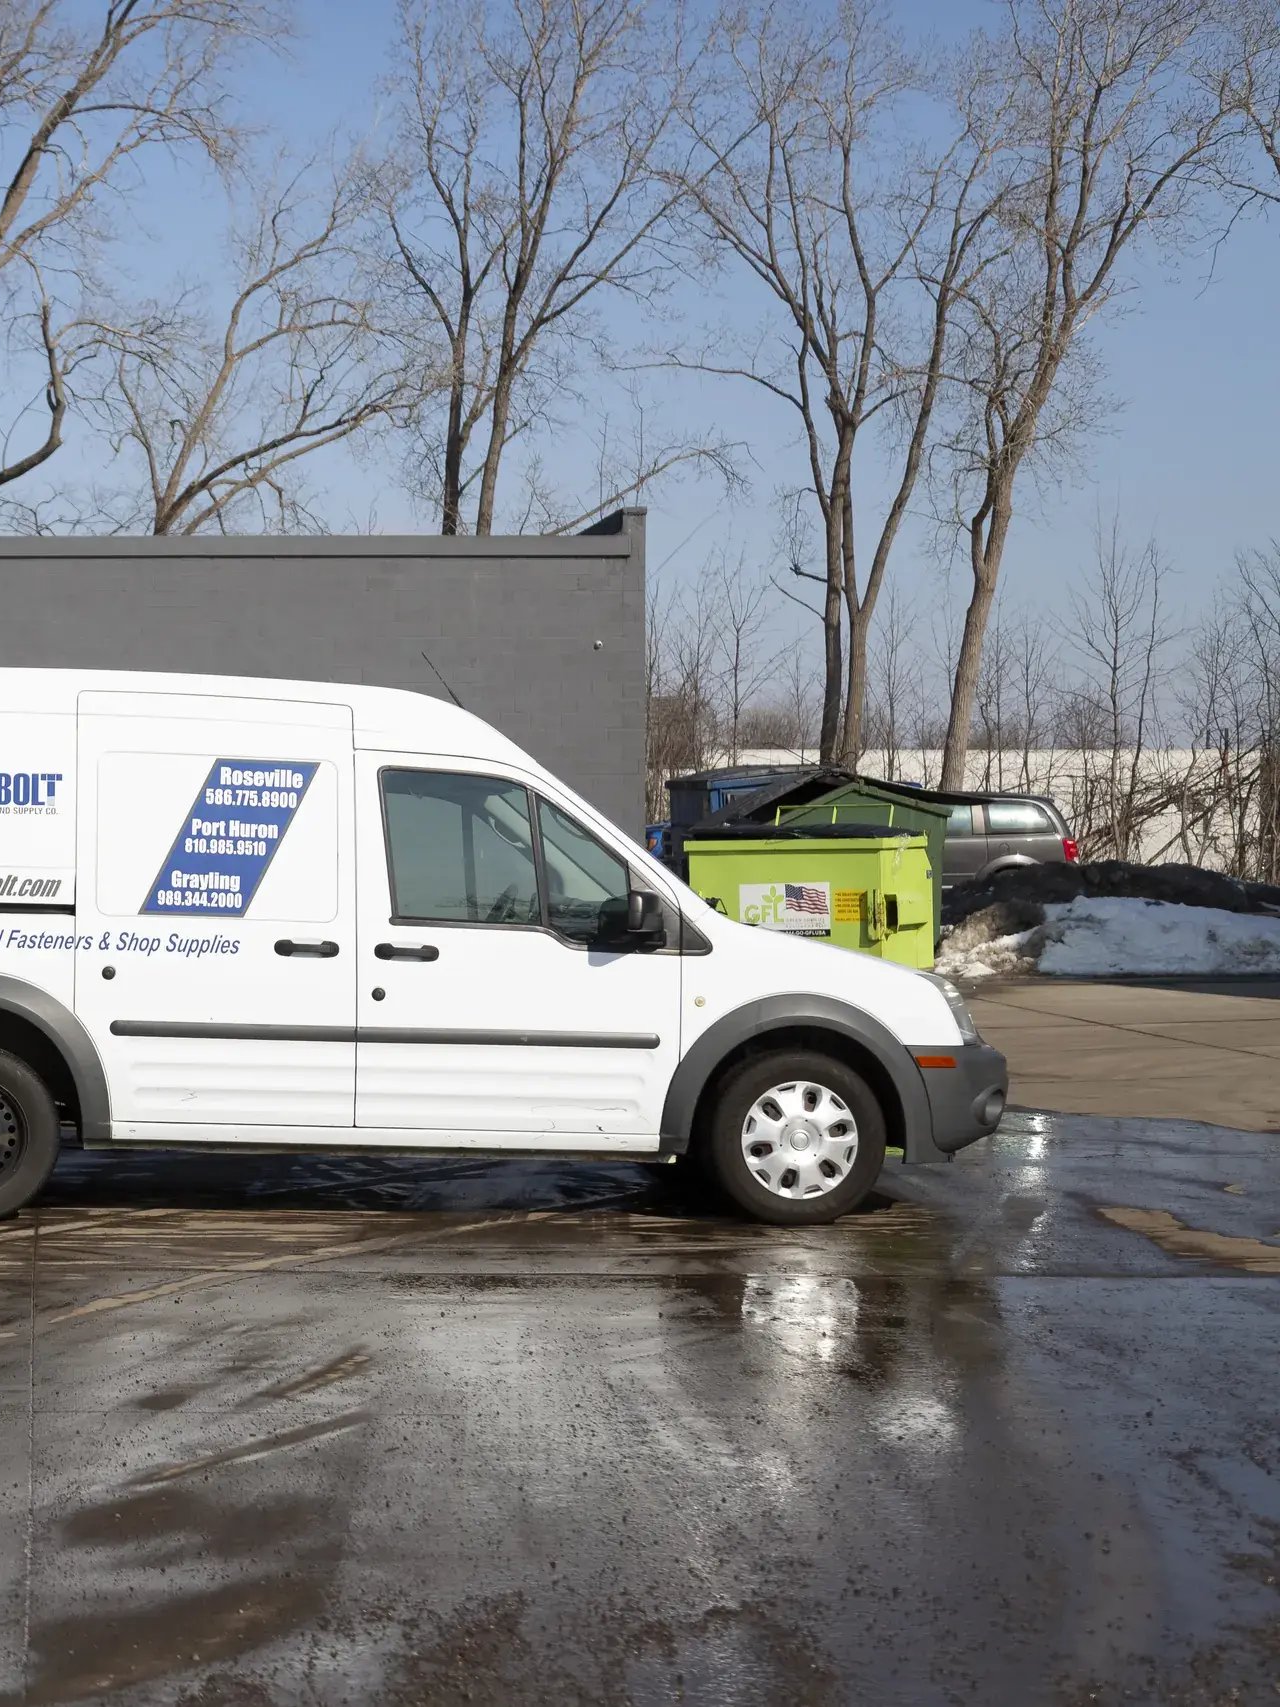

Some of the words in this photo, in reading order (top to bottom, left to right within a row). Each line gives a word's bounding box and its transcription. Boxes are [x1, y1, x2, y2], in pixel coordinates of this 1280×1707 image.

[220, 766, 304, 789] Roseville
[205, 788, 298, 809] 586.775.8900
[12, 806, 43, 815] SUPPLY
[191, 818, 226, 837] Port
[228, 819, 279, 839] Huron
[184, 838, 267, 856] 810.985.9510
[171, 870, 241, 892] Grayling
[157, 890, 243, 909] 989.344.2000
[744, 896, 785, 923] GFL
[6, 929, 94, 950] Fasteners
[98, 931, 111, 951] &
[116, 931, 161, 957] Shop
[165, 933, 241, 958] Supplies
